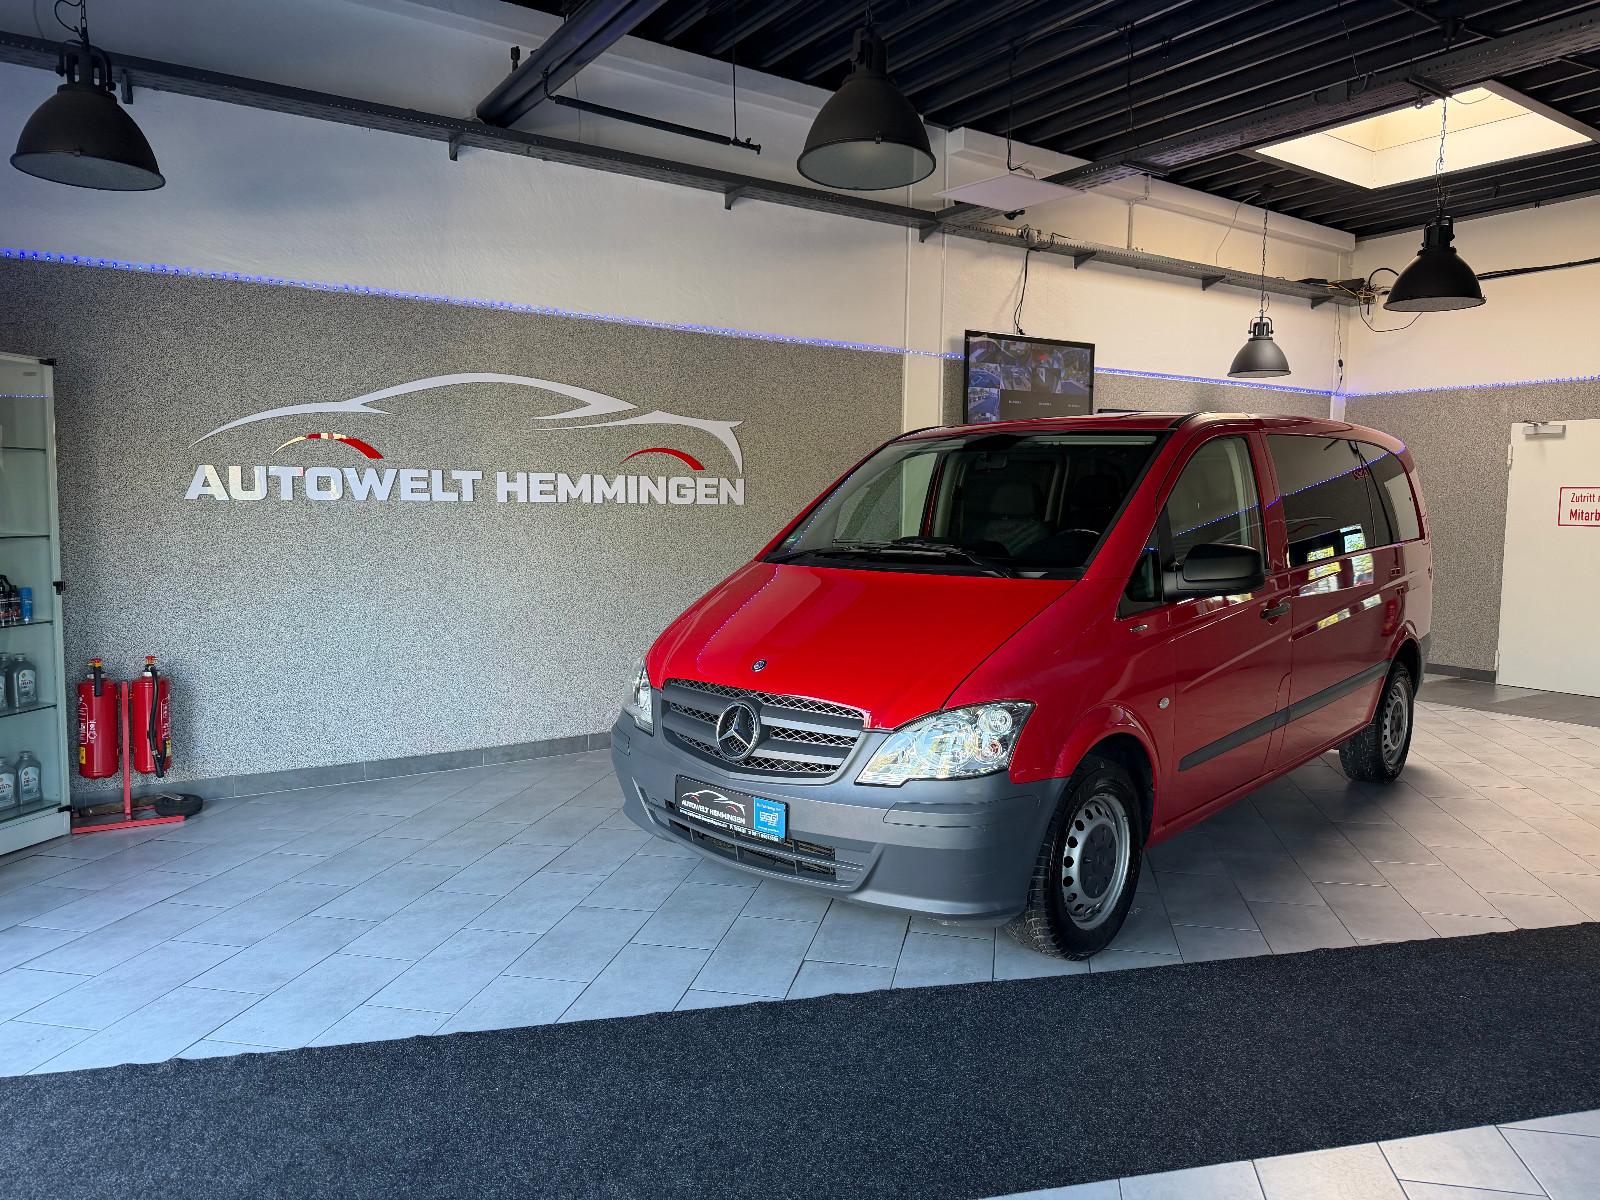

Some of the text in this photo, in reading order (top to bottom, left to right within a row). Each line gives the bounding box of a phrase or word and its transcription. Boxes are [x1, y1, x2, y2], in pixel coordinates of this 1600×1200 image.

[185, 464, 746, 506] AUTOWELT HEMMINGEN
[1570, 492, 1596, 503] Zutritt
[681, 799, 710, 814] AUTOWELT
